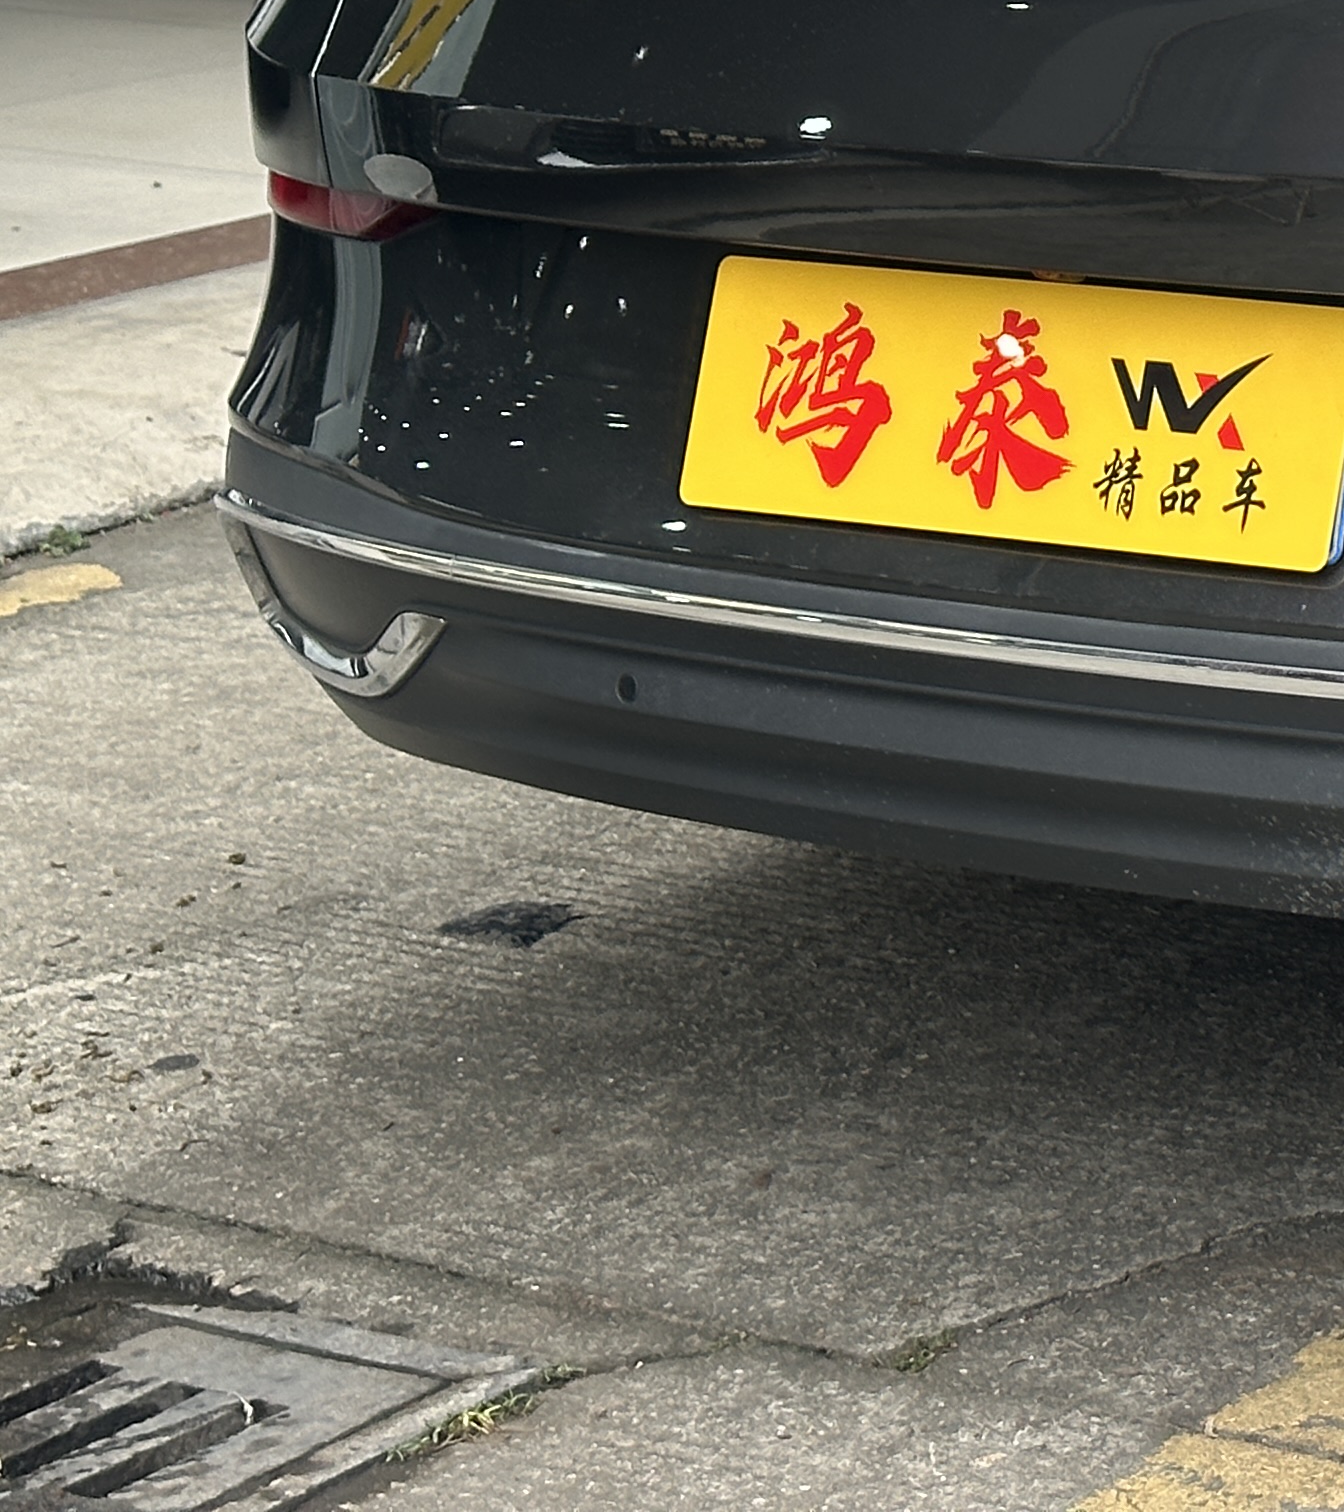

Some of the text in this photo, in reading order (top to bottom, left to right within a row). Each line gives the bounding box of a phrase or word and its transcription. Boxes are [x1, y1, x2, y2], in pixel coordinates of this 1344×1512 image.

[754, 303, 1075, 510] 鸿泰
[1092, 447, 1267, 535] 精品车
